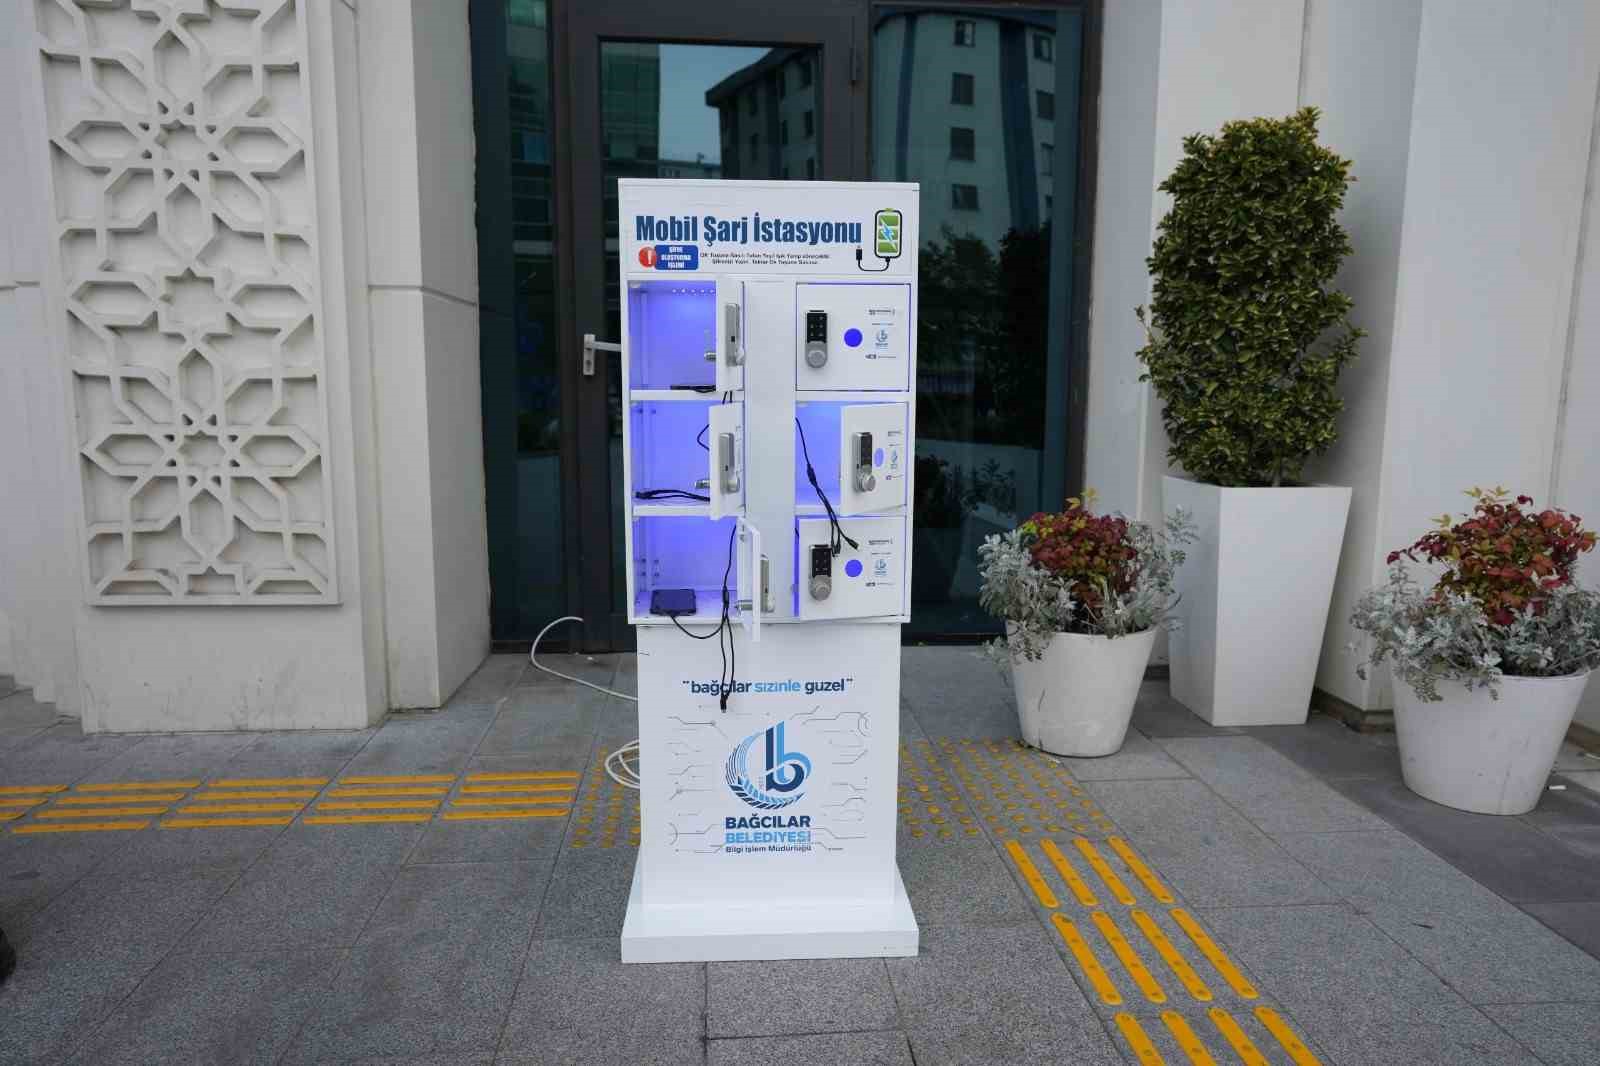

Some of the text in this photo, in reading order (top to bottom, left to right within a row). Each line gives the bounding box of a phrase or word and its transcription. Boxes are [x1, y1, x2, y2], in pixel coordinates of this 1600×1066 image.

[636, 211, 862, 247] Mobil Şarj İstasyonu
[725, 813, 811, 829] BAĞCILAR
